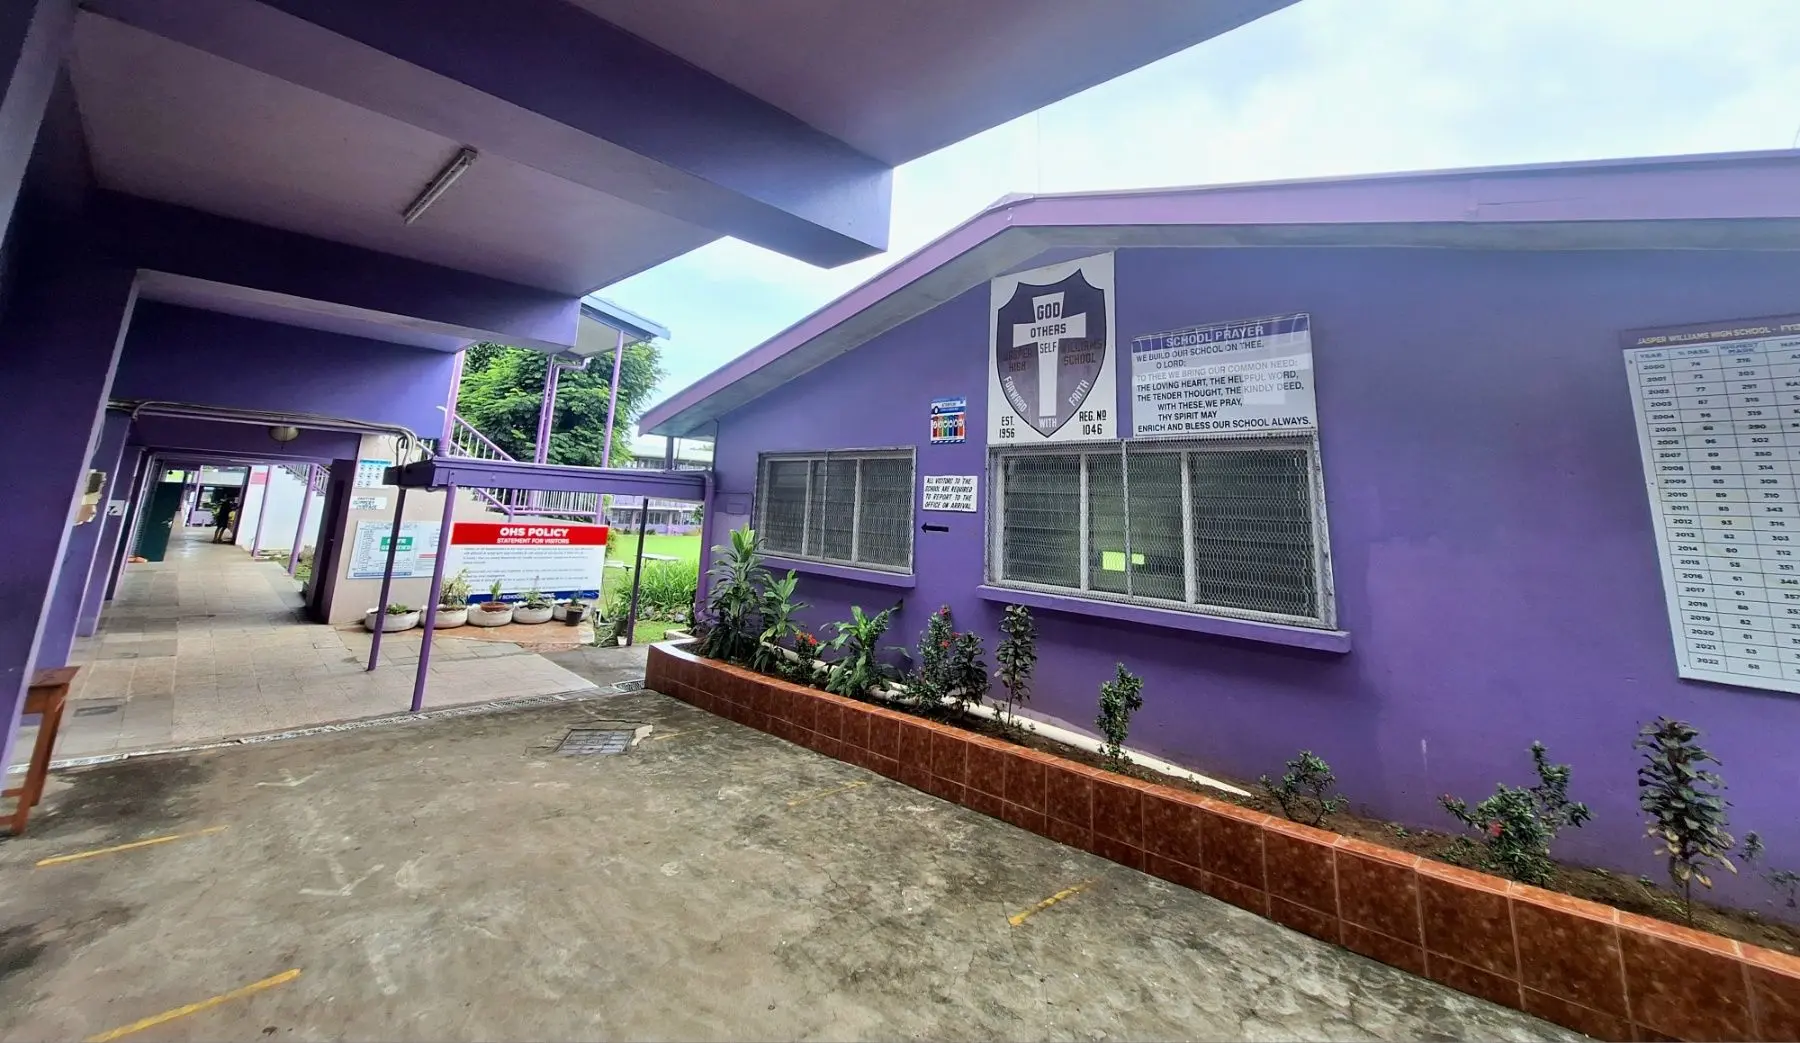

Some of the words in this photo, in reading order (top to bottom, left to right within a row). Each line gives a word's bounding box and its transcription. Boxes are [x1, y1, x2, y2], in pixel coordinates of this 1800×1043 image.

[1037, 302, 1060, 320] GOD
[1030, 323, 1066, 338] OTHERS
[1166, 332, 1212, 347] SCHOOL
[1215, 325, 1264, 340] PRAYER
[1637, 335, 1667, 344] JASPER
[1668, 332, 1709, 342] WILLIAMS
[1733, 326, 1772, 337] SCHOOL
[1039, 341, 1057, 354] SELF
[1136, 354, 1147, 362] WE
[1149, 351, 1170, 361] BUILD
[1172, 349, 1188, 358] OUR
[1190, 345, 1223, 356] SCHOOL
[1225, 343, 1238, 351] ON
[1009, 361, 1026, 372] HIGH
[1063, 353, 1096, 366] SCHOOL
[1156, 361, 1162, 369] O
[1148, 372, 1167, 381] THEE
[1168, 370, 1180, 378] WE
[1182, 368, 1206, 377] BRING
[1208, 366, 1226, 374] OUR
[1228, 362, 1268, 373] COMMON
[1137, 384, 1150, 392] THE
[1152, 381, 1179, 390] LOVING
[1181, 378, 1208, 388] HEART,
[1210, 376, 1226, 385] THE
[1228, 373, 1266, 383] HELPFUL
[1268, 370, 1298, 380] WORD,
[1003, 375, 1028, 413] FORWARD
[1068, 379, 1090, 407] FAITH
[1137, 394, 1151, 402] THE
[1152, 392, 1182, 400] TENDER
[1184, 388, 1223, 398] THOUGHT,
[1225, 386, 1242, 395] THE
[1243, 383, 1274, 394] KINDLY
[1277, 381, 1304, 391] DEED,
[1158, 403, 1176, 411] WITH
[1220, 398, 1243, 407] PRAY,
[1001, 416, 1015, 426] EST.
[1038, 418, 1057, 429] WITH
[1079, 411, 1096, 422] REG.
[1174, 412, 1199, 421] SPIRIT
[1201, 411, 1217, 419] MAY
[1082, 424, 1103, 435] 1046
[1138, 424, 1165, 432] ENRICH
[1167, 423, 1183, 431] AND
[1185, 422, 1210, 430] BLESS
[1212, 420, 1230, 429] OUR
[1232, 419, 1269, 428] SCHOOL
[1272, 416, 1311, 426] ALWAYS.
[999, 427, 1015, 438] 1956
[500, 527, 526, 537] OHS
[528, 527, 570, 537] POLICY
